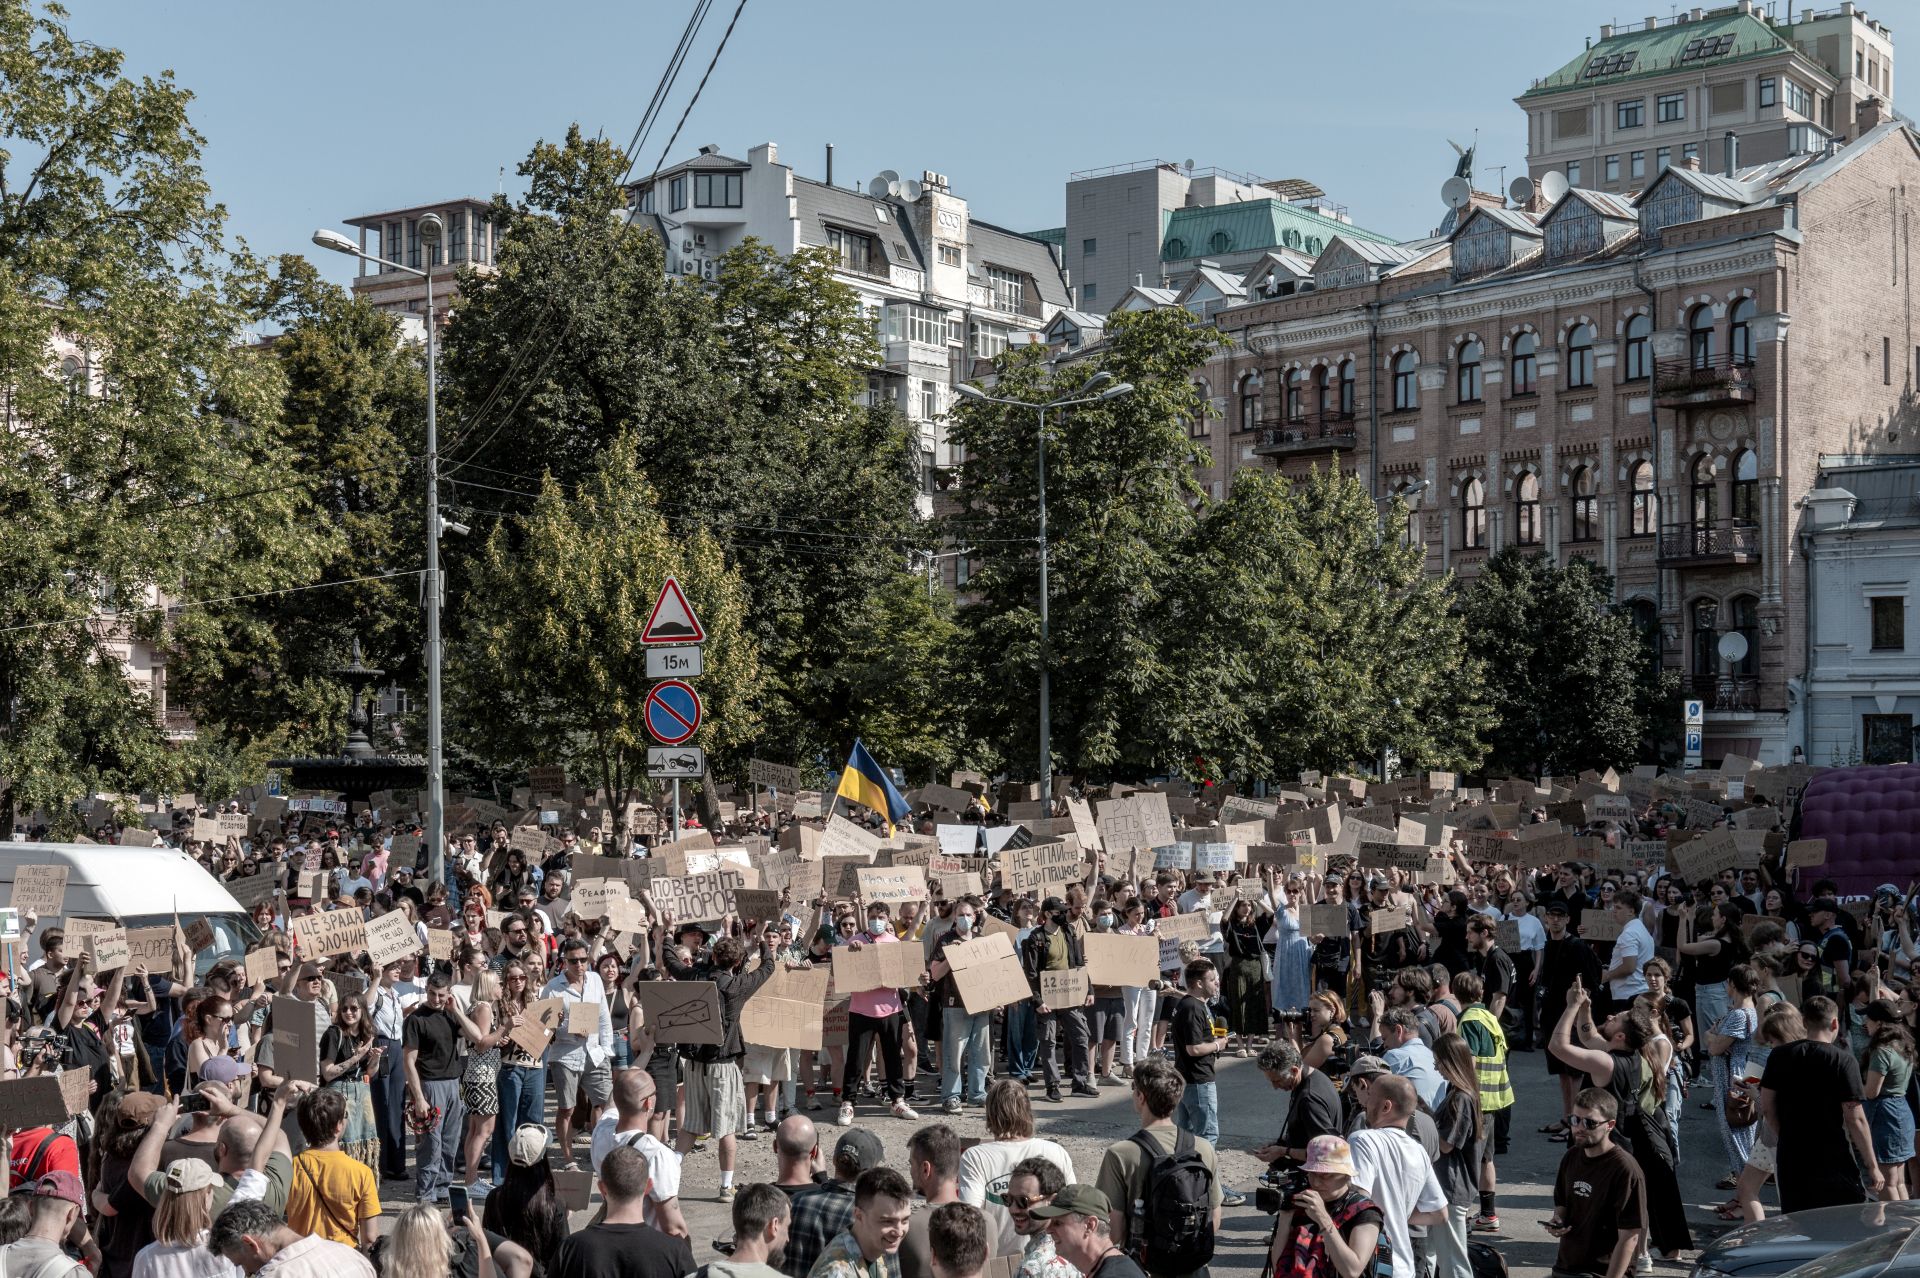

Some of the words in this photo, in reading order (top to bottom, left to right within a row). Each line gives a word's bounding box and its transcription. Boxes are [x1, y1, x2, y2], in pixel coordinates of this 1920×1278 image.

[1690, 734, 1698, 749] P
[1596, 807, 1627, 817] ГАНЬБА
[896, 849, 933, 866] ГАНЬБ
[1013, 850, 1031, 870] НЕ
[652, 869, 745, 898] ПОВЕРНІТЬ
[1012, 872, 1025, 890] ТЕ
[1042, 864, 1079, 883] ПРАЦЮЄ
[301, 919, 321, 937] ЦЕ
[321, 910, 363, 933] ЗРАДА
[319, 930, 368, 953] ЗЛОЧИН
[1043, 976, 1057, 988] 12
[993, 1181, 1009, 1193] pa
